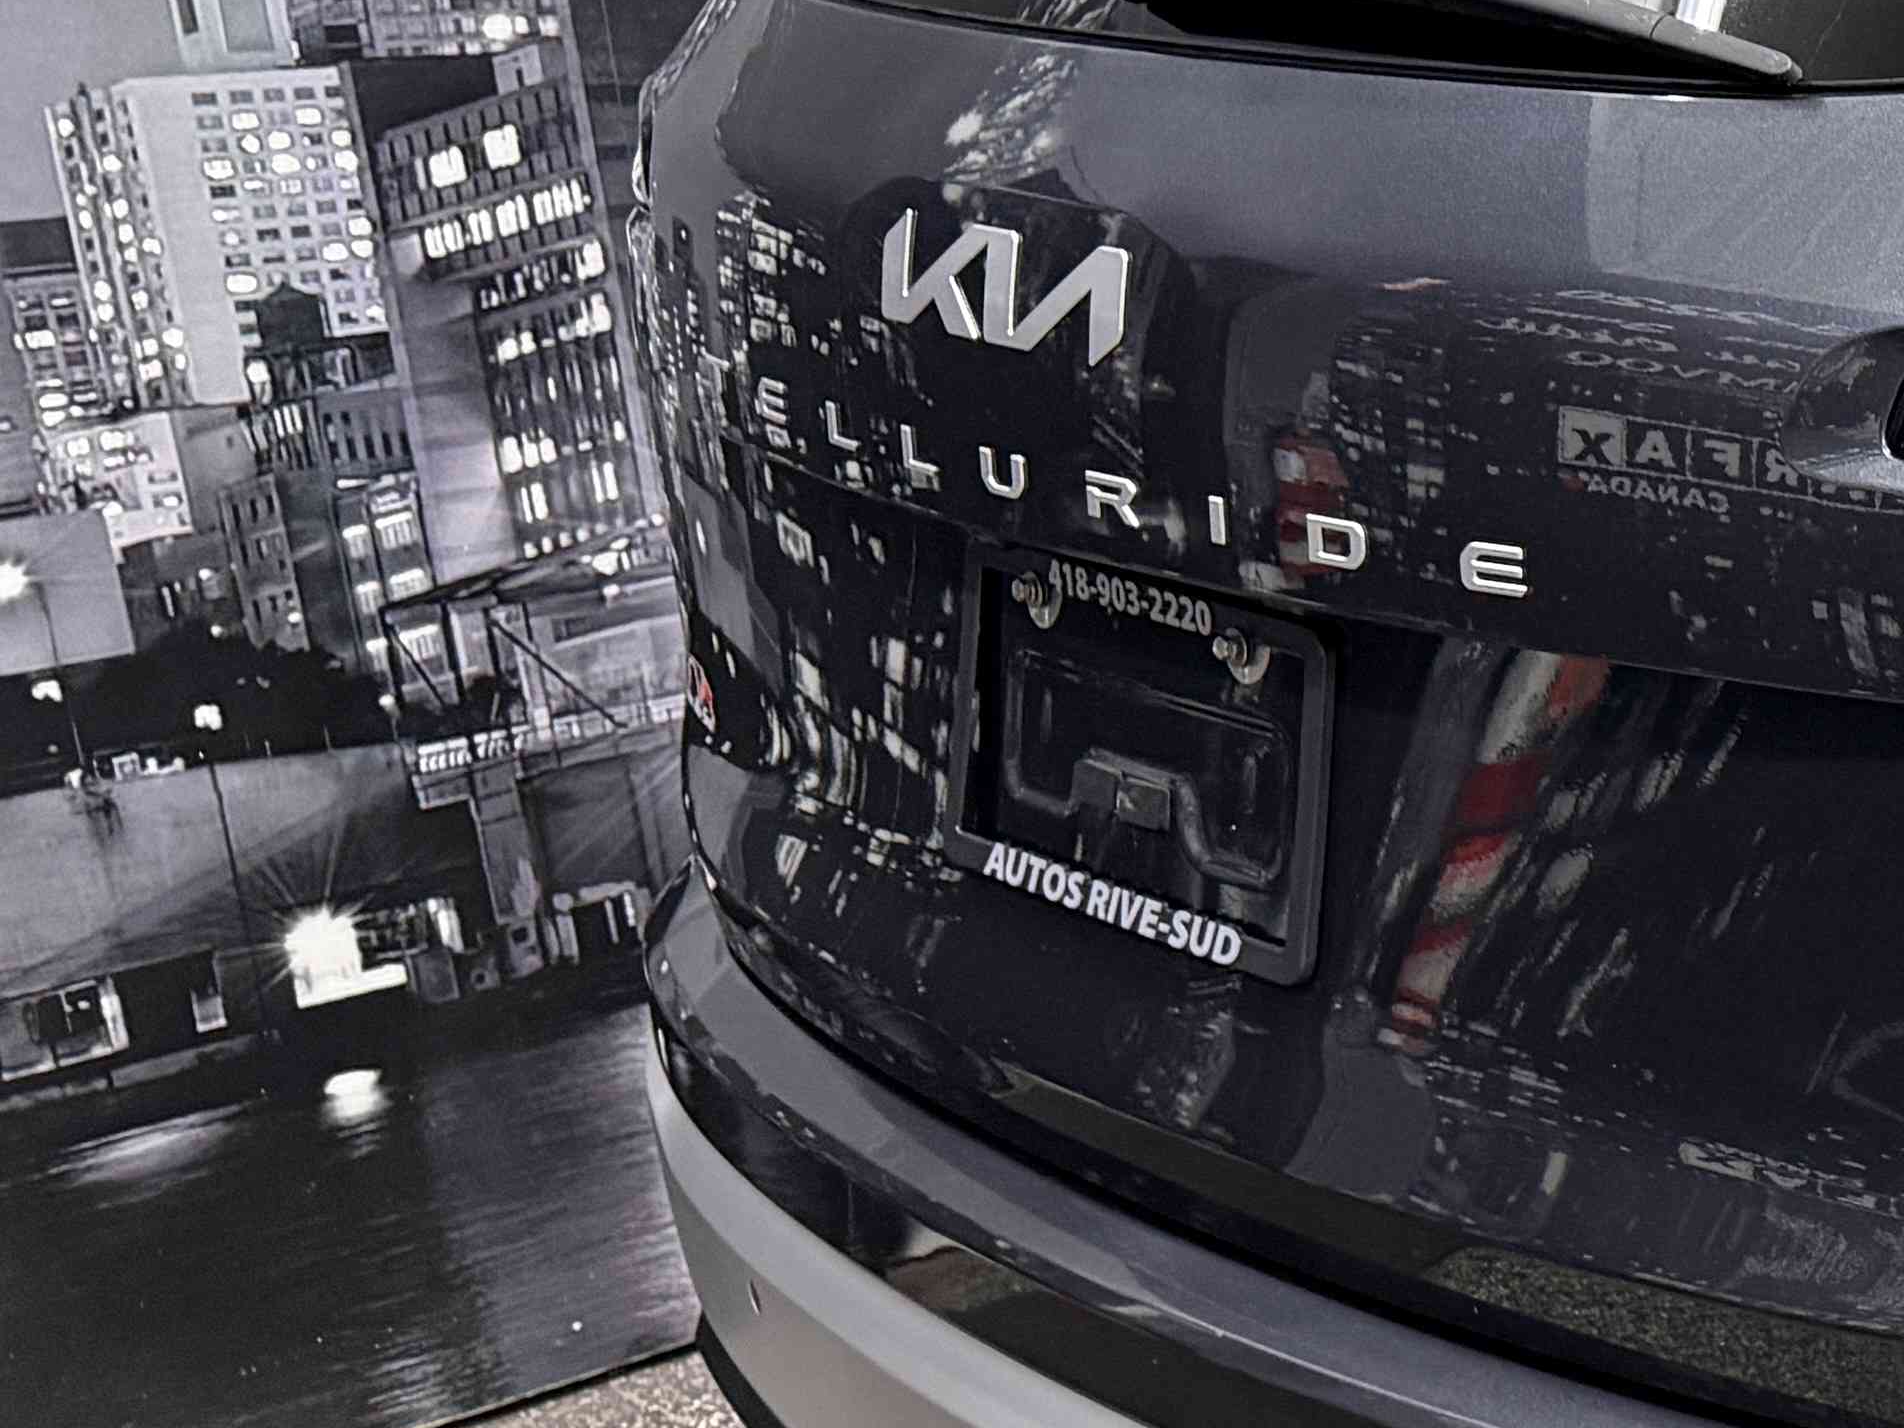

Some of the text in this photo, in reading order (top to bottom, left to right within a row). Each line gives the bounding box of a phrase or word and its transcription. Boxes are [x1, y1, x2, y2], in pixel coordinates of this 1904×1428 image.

[881, 207, 1129, 367] KIA
[1048, 558, 1213, 637] 418-903-2220
[982, 841, 1242, 966] AUTOS RIVE-SUD
